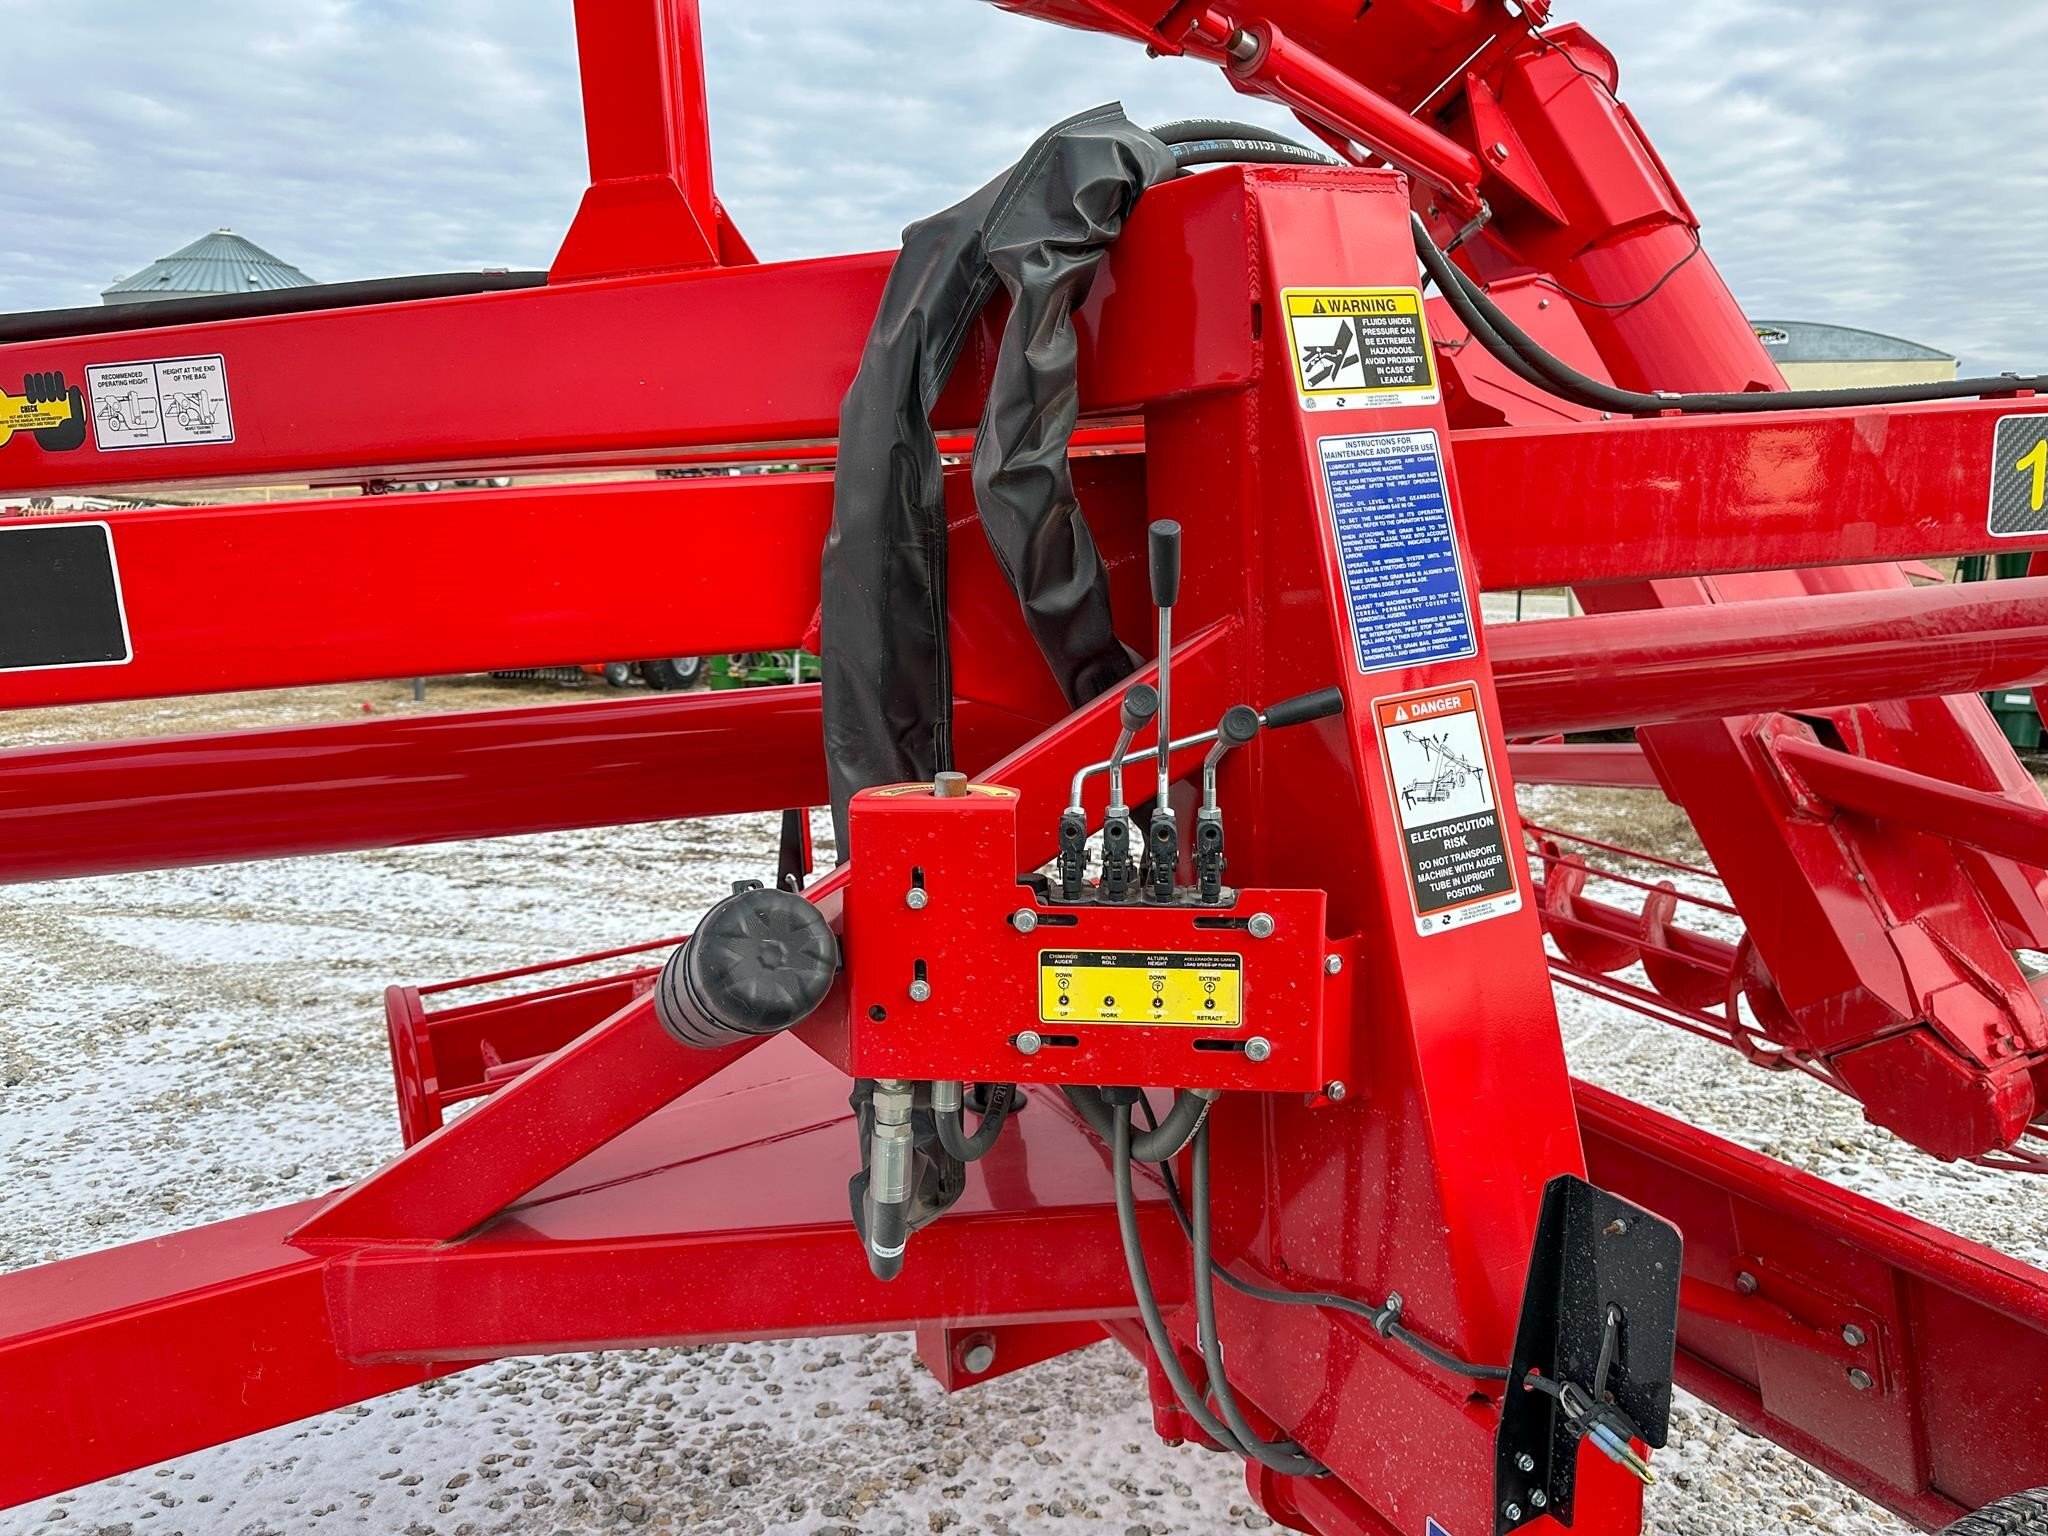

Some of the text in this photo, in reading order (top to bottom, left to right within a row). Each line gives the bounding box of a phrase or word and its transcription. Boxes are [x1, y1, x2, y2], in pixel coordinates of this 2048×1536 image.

[1280, 144, 1320, 160] WINNER
[1327, 297, 1396, 313] WARNING
[1362, 327, 1399, 335] PRESSURE
[1375, 336, 1416, 345] EXTREMELY
[1369, 346, 1414, 355] HAZARDOUS.
[1386, 355, 1423, 364] PROXIMITY
[100, 371, 142, 380] RECOMMENDED
[1380, 375, 1415, 384] LEAKAGE.
[97, 379, 127, 388] OPERATING
[20, 404, 38, 413] CHECK
[1344, 438, 1395, 448] INSTRUCTIONS
[1323, 448, 1374, 458] MAINTENANCE
[1391, 445, 1419, 453] PROPER
[1379, 563, 1406, 571] STRETCHED
[1355, 609, 1378, 617] CEREAL
[1381, 603, 1422, 613] PERMANENTLY
[1356, 614, 1385, 623] HORIZONTAL
[1410, 695, 1461, 716] DANGER
[1410, 815, 1494, 844] ELECTROCUTION
[1442, 834, 1468, 850] RISK
[1418, 843, 1497, 870] DO NOT TRANSPORT
[1417, 854, 1502, 883] MACHINE WITH AUGER
[1429, 867, 1496, 892] TUBE IN UPRIGHT
[1445, 882, 1484, 900] POSITION.
